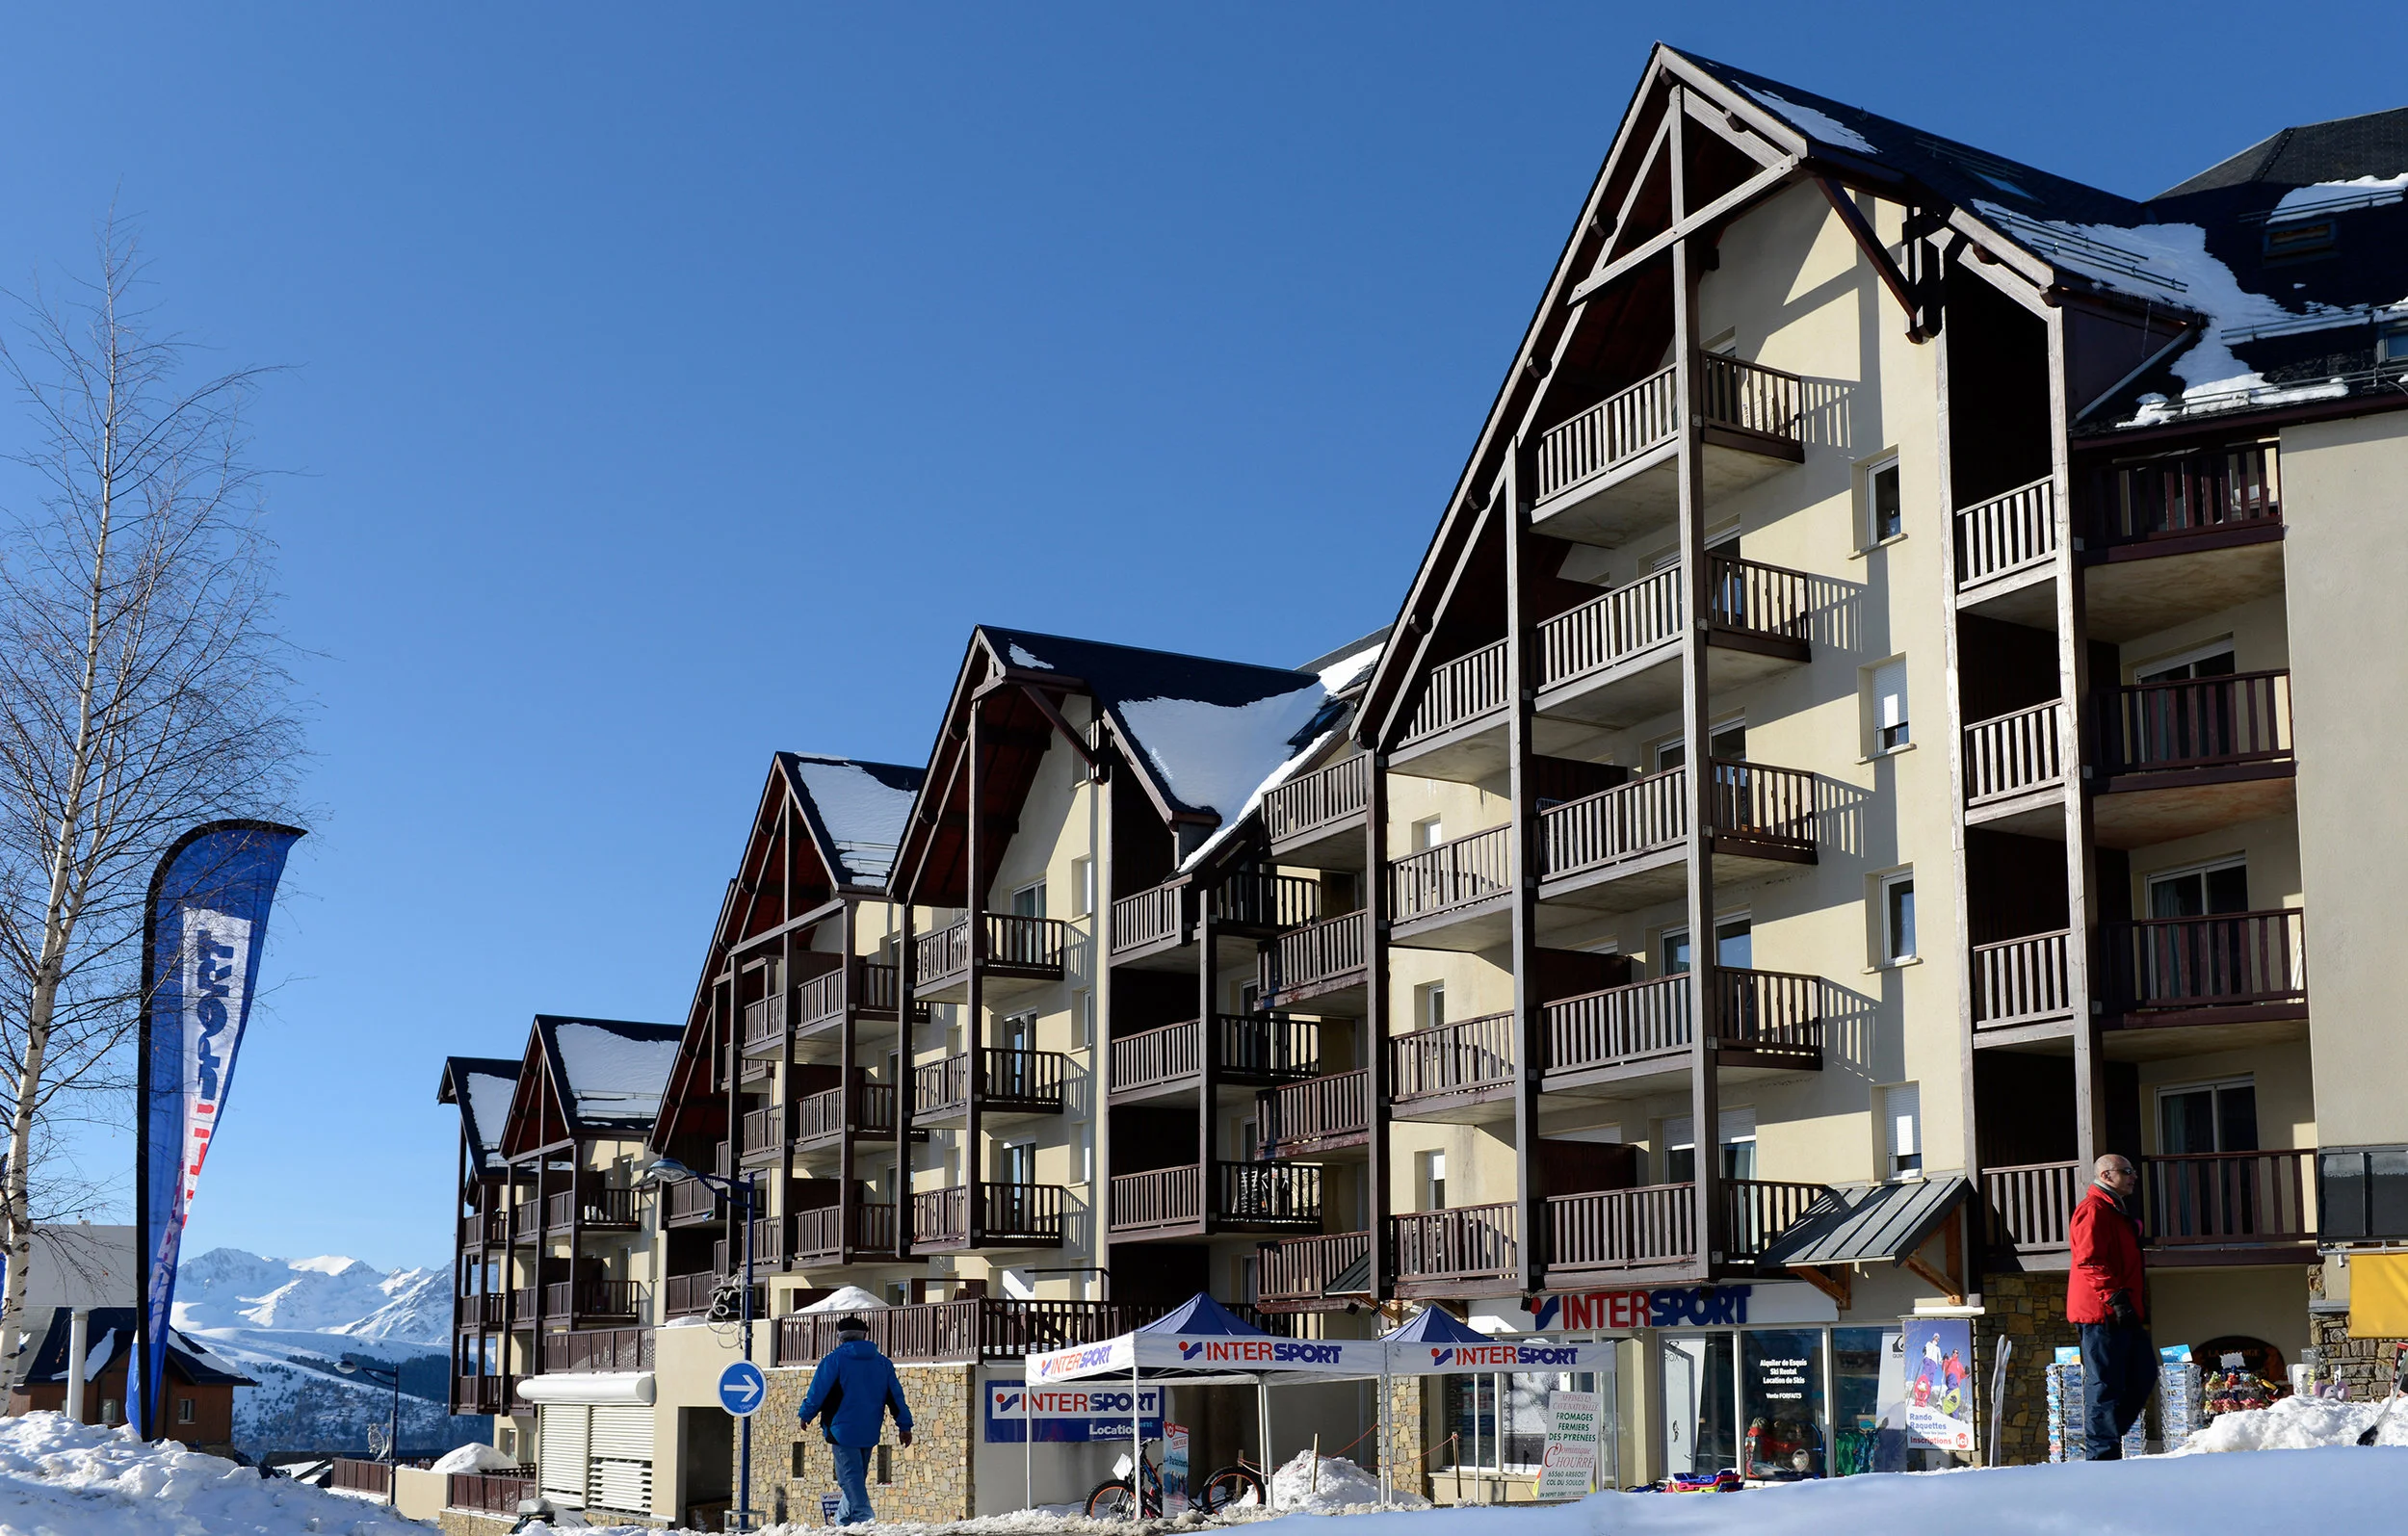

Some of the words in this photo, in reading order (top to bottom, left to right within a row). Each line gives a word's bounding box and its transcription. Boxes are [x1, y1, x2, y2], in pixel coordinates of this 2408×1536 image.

[1562, 1285, 1751, 1330] INTERSPORT
[1207, 1341, 1342, 1364] INTERSPORT
[1456, 1346, 1578, 1365] INTERSPORT
[1051, 1345, 1112, 1375] INTERSPORT
[1760, 1359, 1781, 1367] Alquiler
[1022, 1393, 1157, 1412] INTERSPORT
[1556, 1412, 1593, 1421] FROMAGES
[1089, 1424, 1136, 1435] Locatio
[1557, 1422, 1589, 1432] FERMIERS
[1909, 1421, 1948, 1430] Raquettes
[1549, 1433, 1560, 1442] DES
[1563, 1432, 1596, 1443] PYRÉNÉES
[1910, 1436, 1952, 1446] Inscriptions
